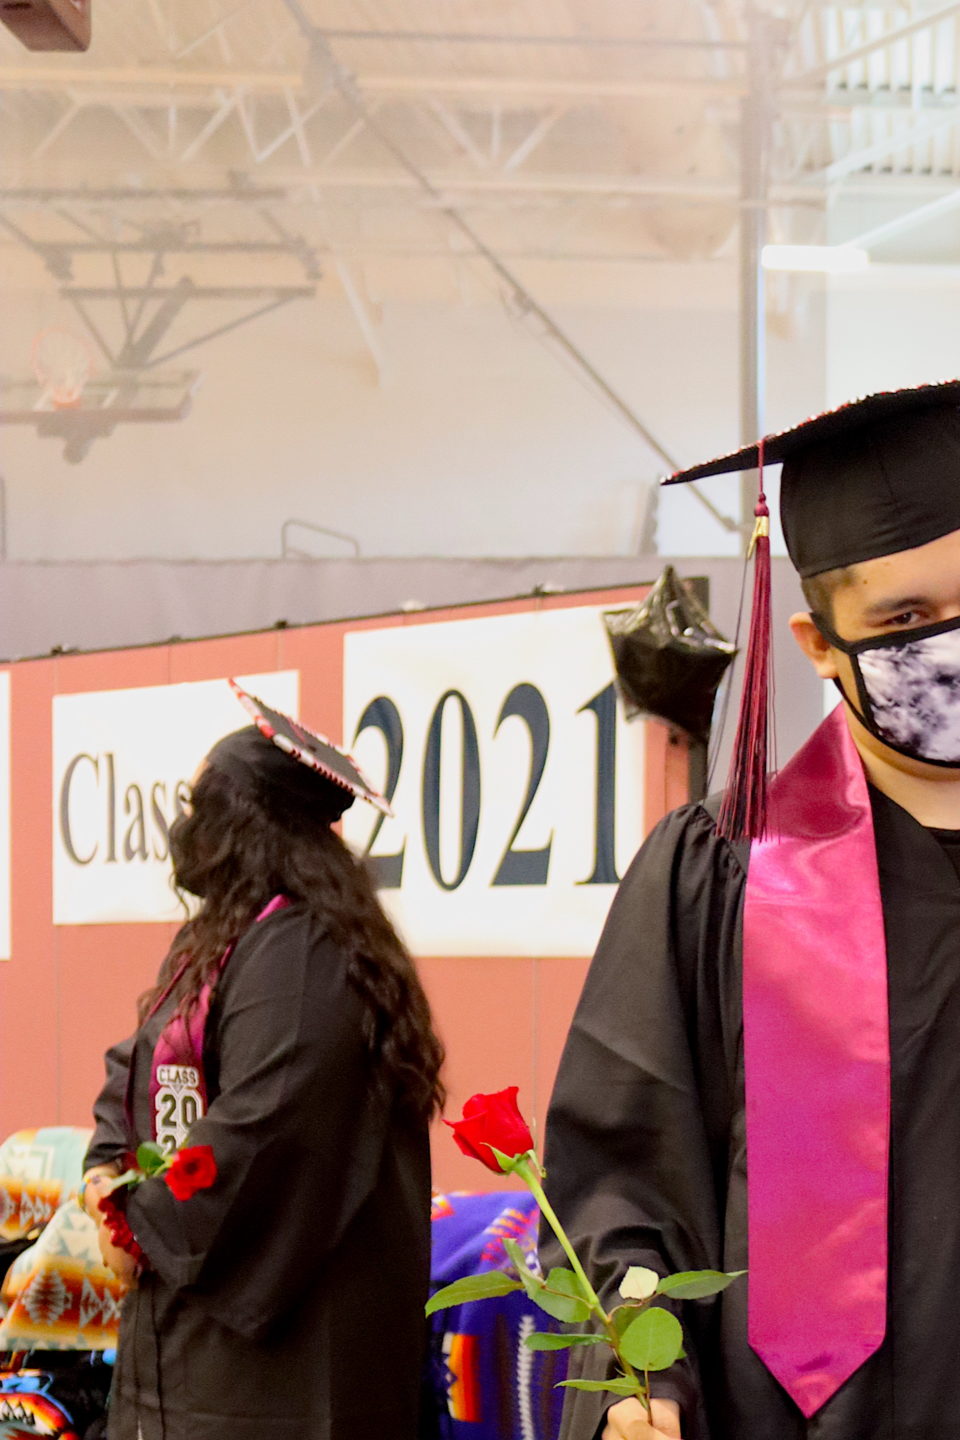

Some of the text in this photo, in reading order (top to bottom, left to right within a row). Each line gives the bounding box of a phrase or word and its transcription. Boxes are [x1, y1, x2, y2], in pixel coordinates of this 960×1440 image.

[350, 682, 623, 892] 2021
[159, 1068, 196, 1085] CLASS
[161, 1093, 198, 1128] 20
